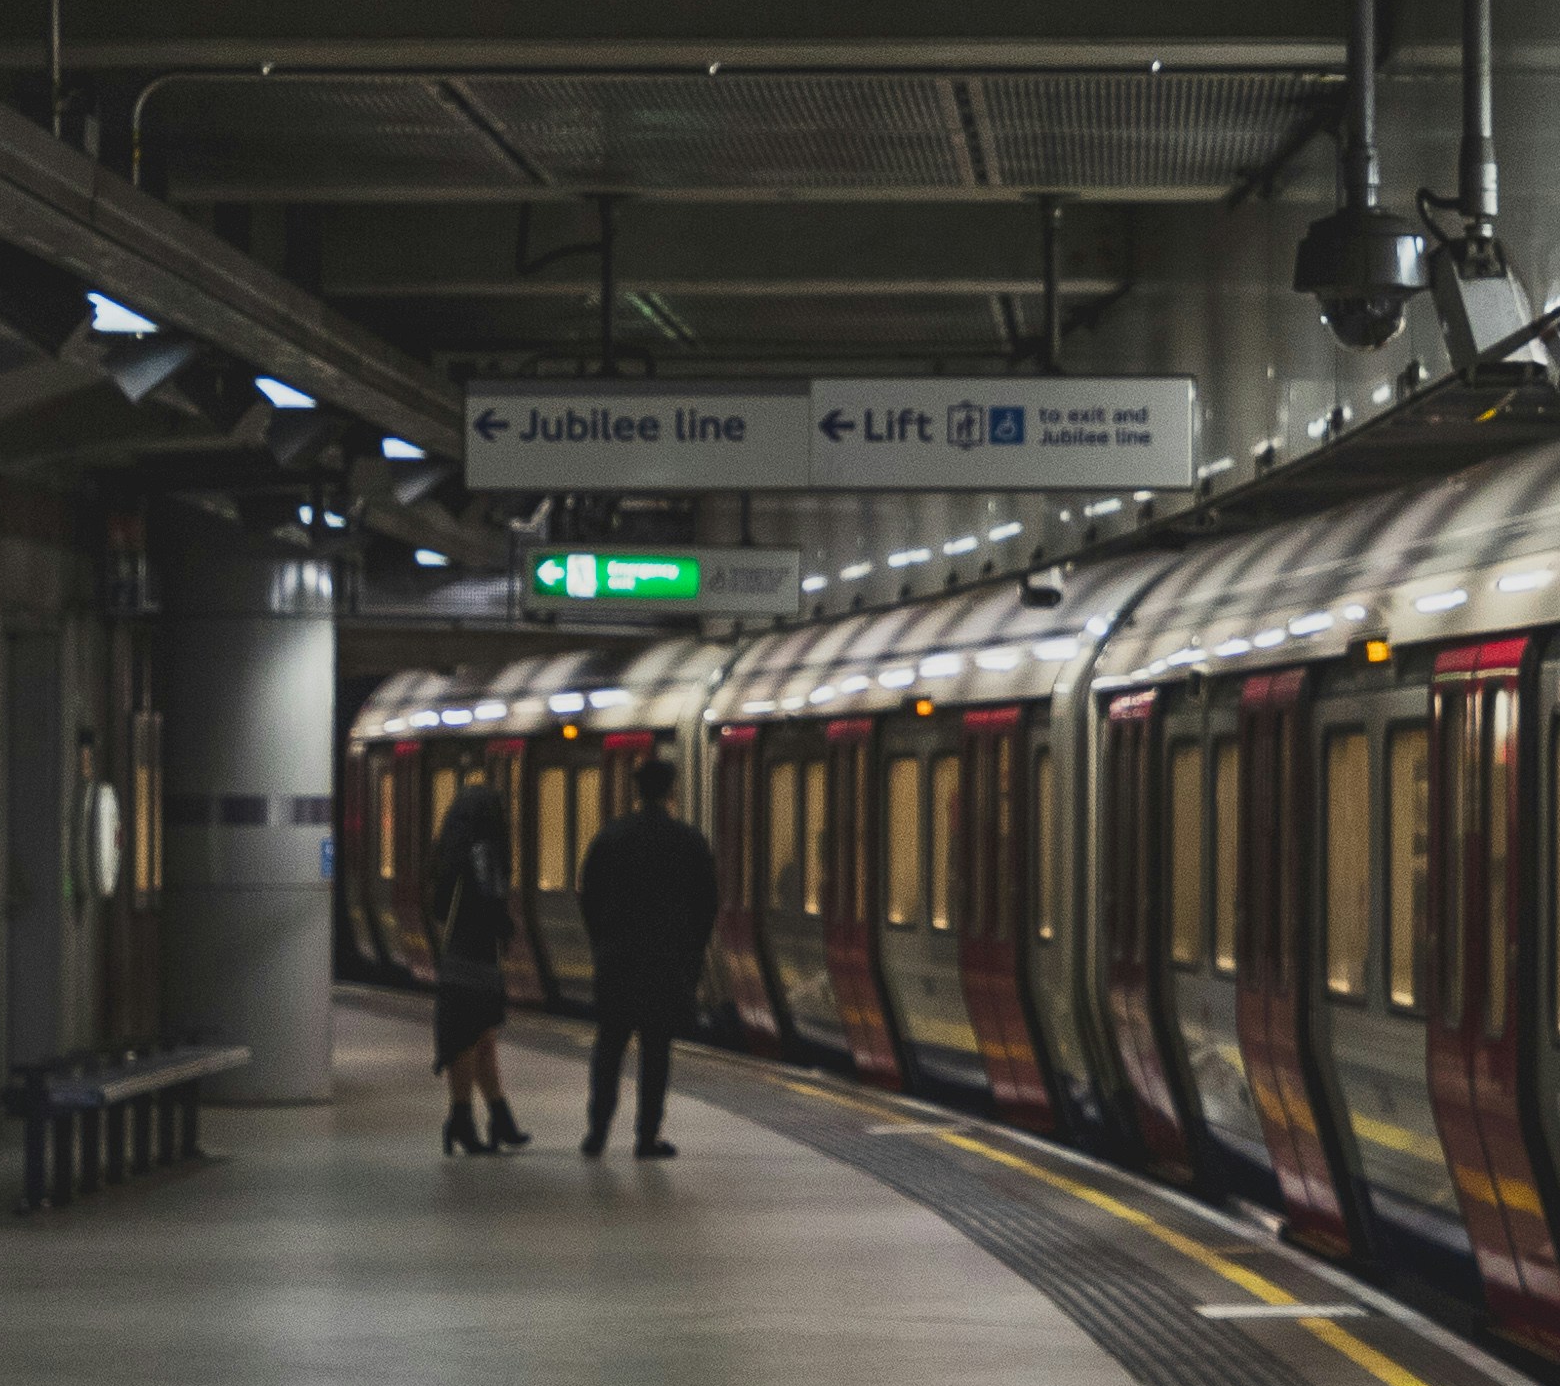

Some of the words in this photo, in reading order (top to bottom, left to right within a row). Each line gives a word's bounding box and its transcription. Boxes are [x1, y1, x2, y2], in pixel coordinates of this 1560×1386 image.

[518, 407, 660, 442] Jubilee
[674, 407, 747, 442] line
[863, 407, 933, 443] Lift
[1039, 408, 1060, 424] to
[1068, 406, 1107, 424] exit
[1112, 406, 1150, 424] and
[1039, 427, 1109, 446] Jubilee
[1114, 428, 1152, 446] line
